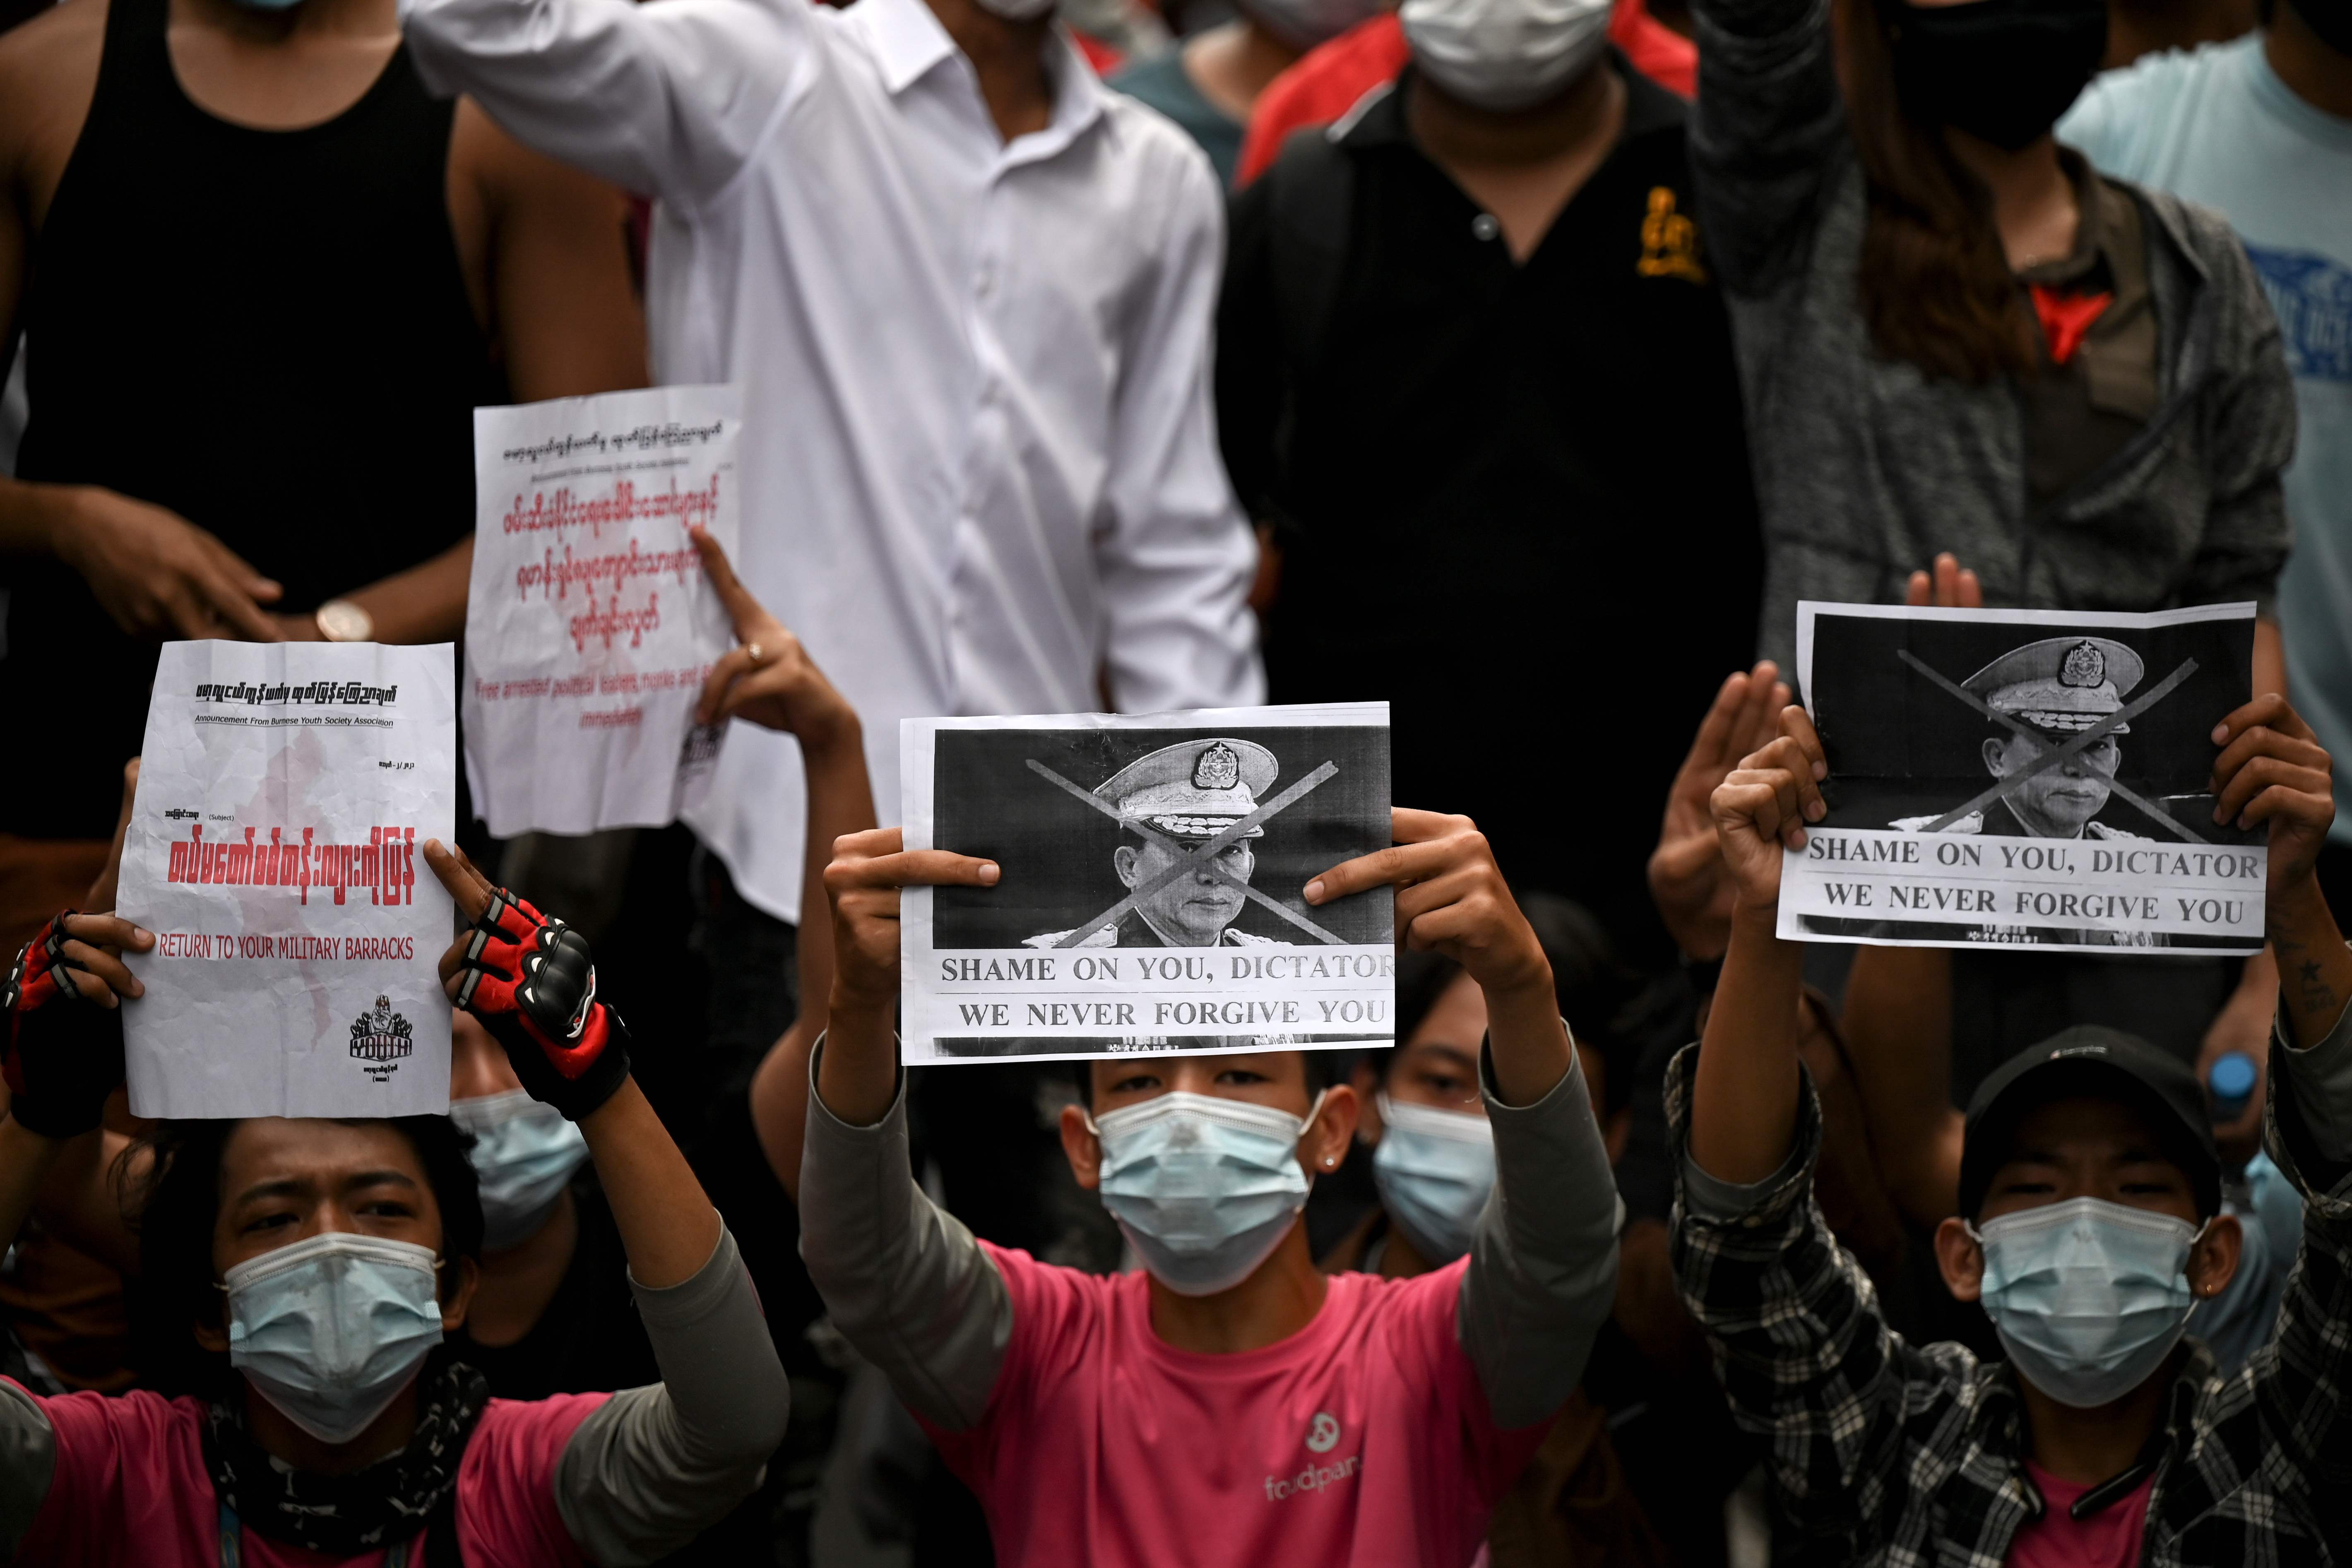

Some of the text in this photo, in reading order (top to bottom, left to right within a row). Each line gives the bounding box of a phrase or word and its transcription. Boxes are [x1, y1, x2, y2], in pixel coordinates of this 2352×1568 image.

[195, 715, 248, 724] Announcement
[250, 717, 269, 726] From
[325, 717, 352, 726] Society
[354, 717, 394, 727] Association
[1809, 837, 2259, 878] SHAME ON YOU, DICTATOR
[1824, 883, 2243, 924] WE NEVER FORGIVE YOU
[160, 933, 414, 960] RETURN TO YOUR MILITARY BARRACKS
[941, 954, 1395, 984] SHAME ON YOU, DICTATOR
[959, 1000, 1385, 1026] WE NEVER FORGIVE YOU
[353, 1034, 409, 1060] YOUTH
